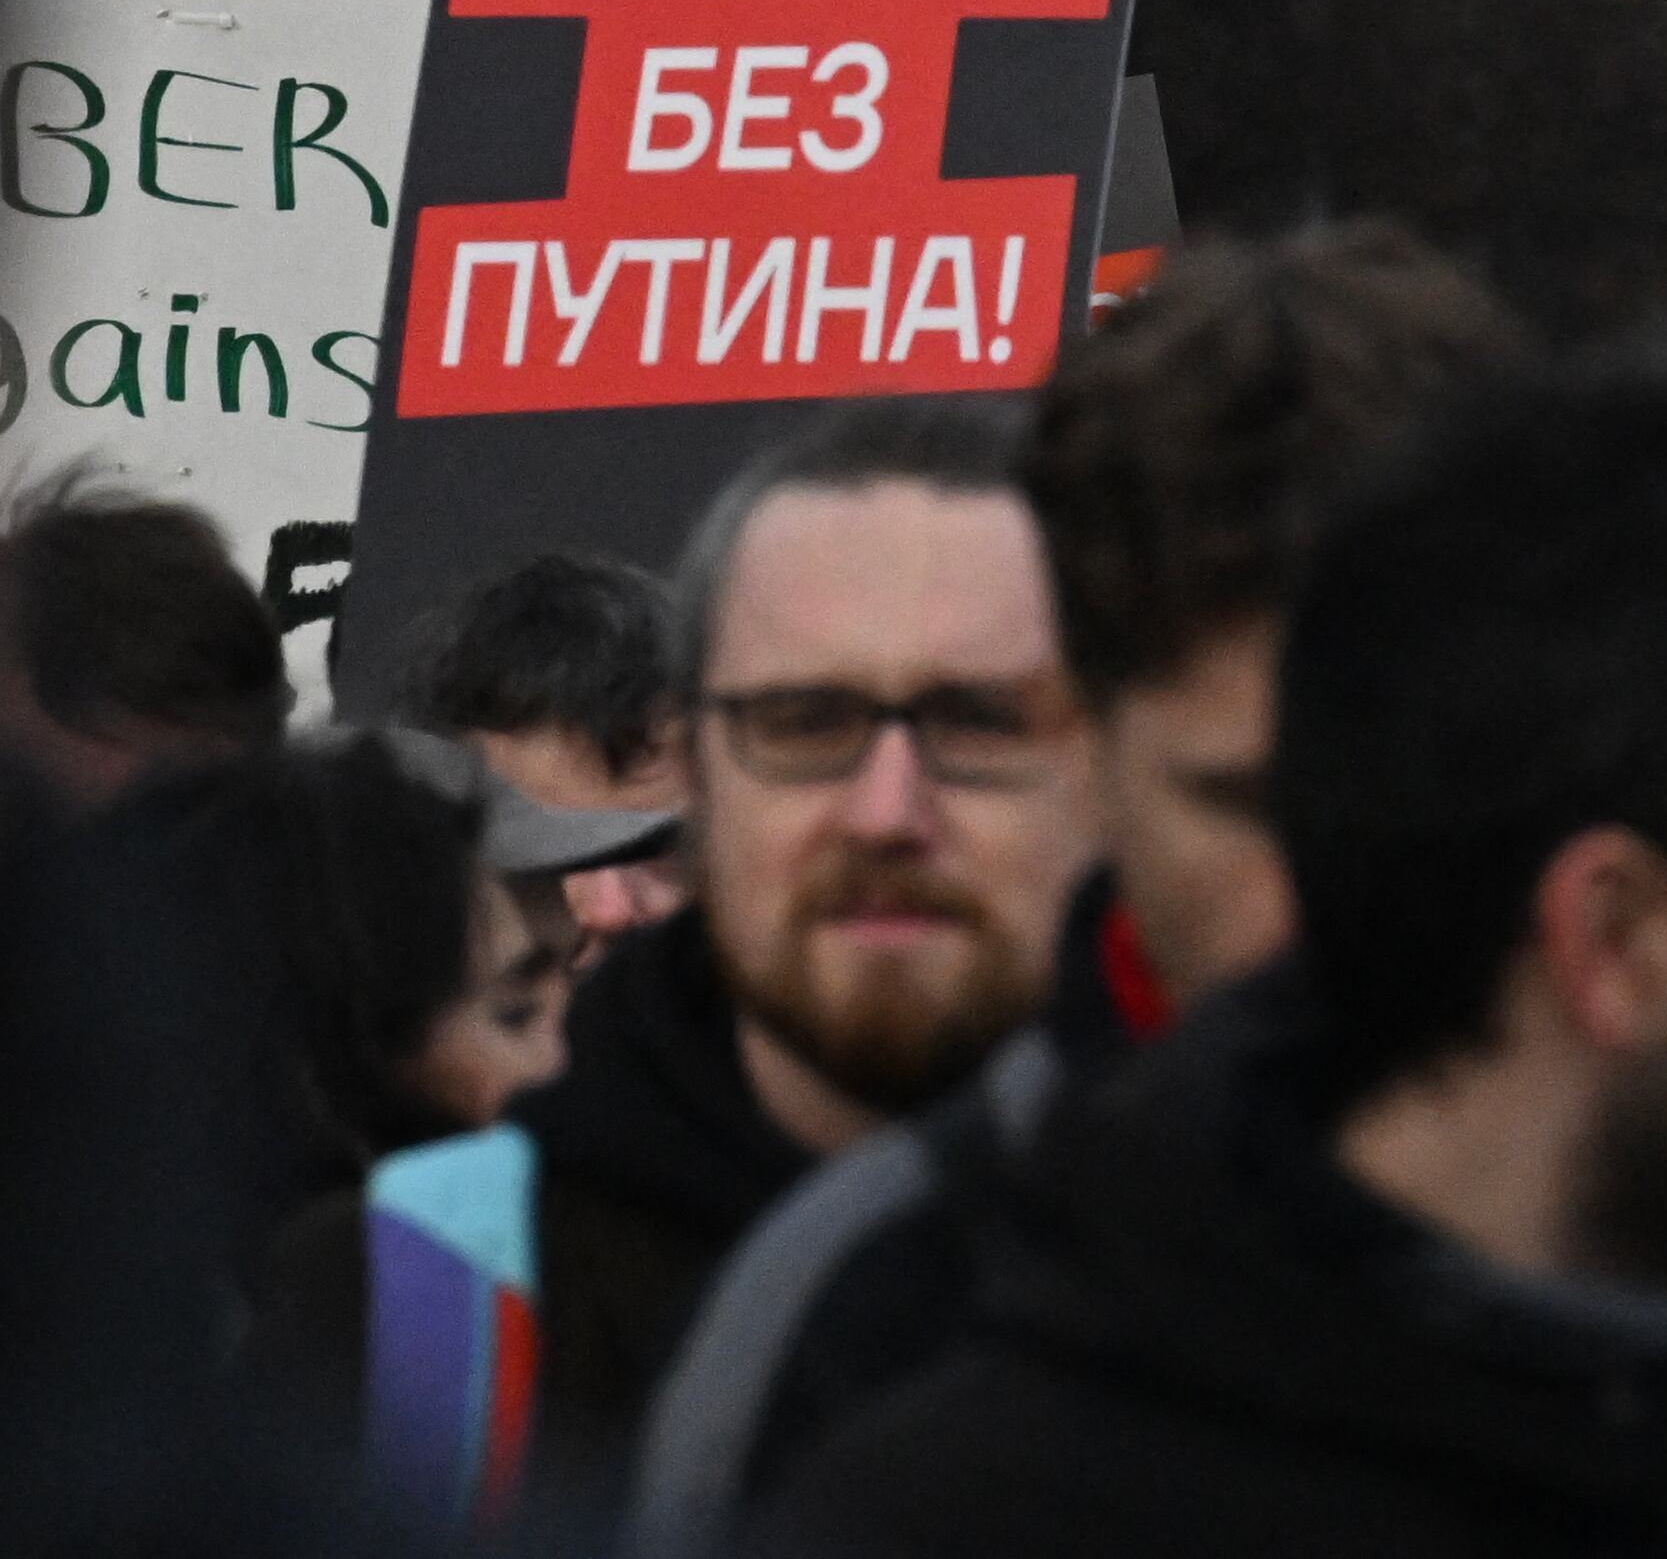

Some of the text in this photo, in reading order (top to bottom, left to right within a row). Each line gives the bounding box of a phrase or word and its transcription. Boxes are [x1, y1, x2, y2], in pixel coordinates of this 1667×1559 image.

[0, 61, 389, 229] BER
[626, 41, 889, 173] БЕЗ
[440, 235, 1025, 368] ПУТИНА!
